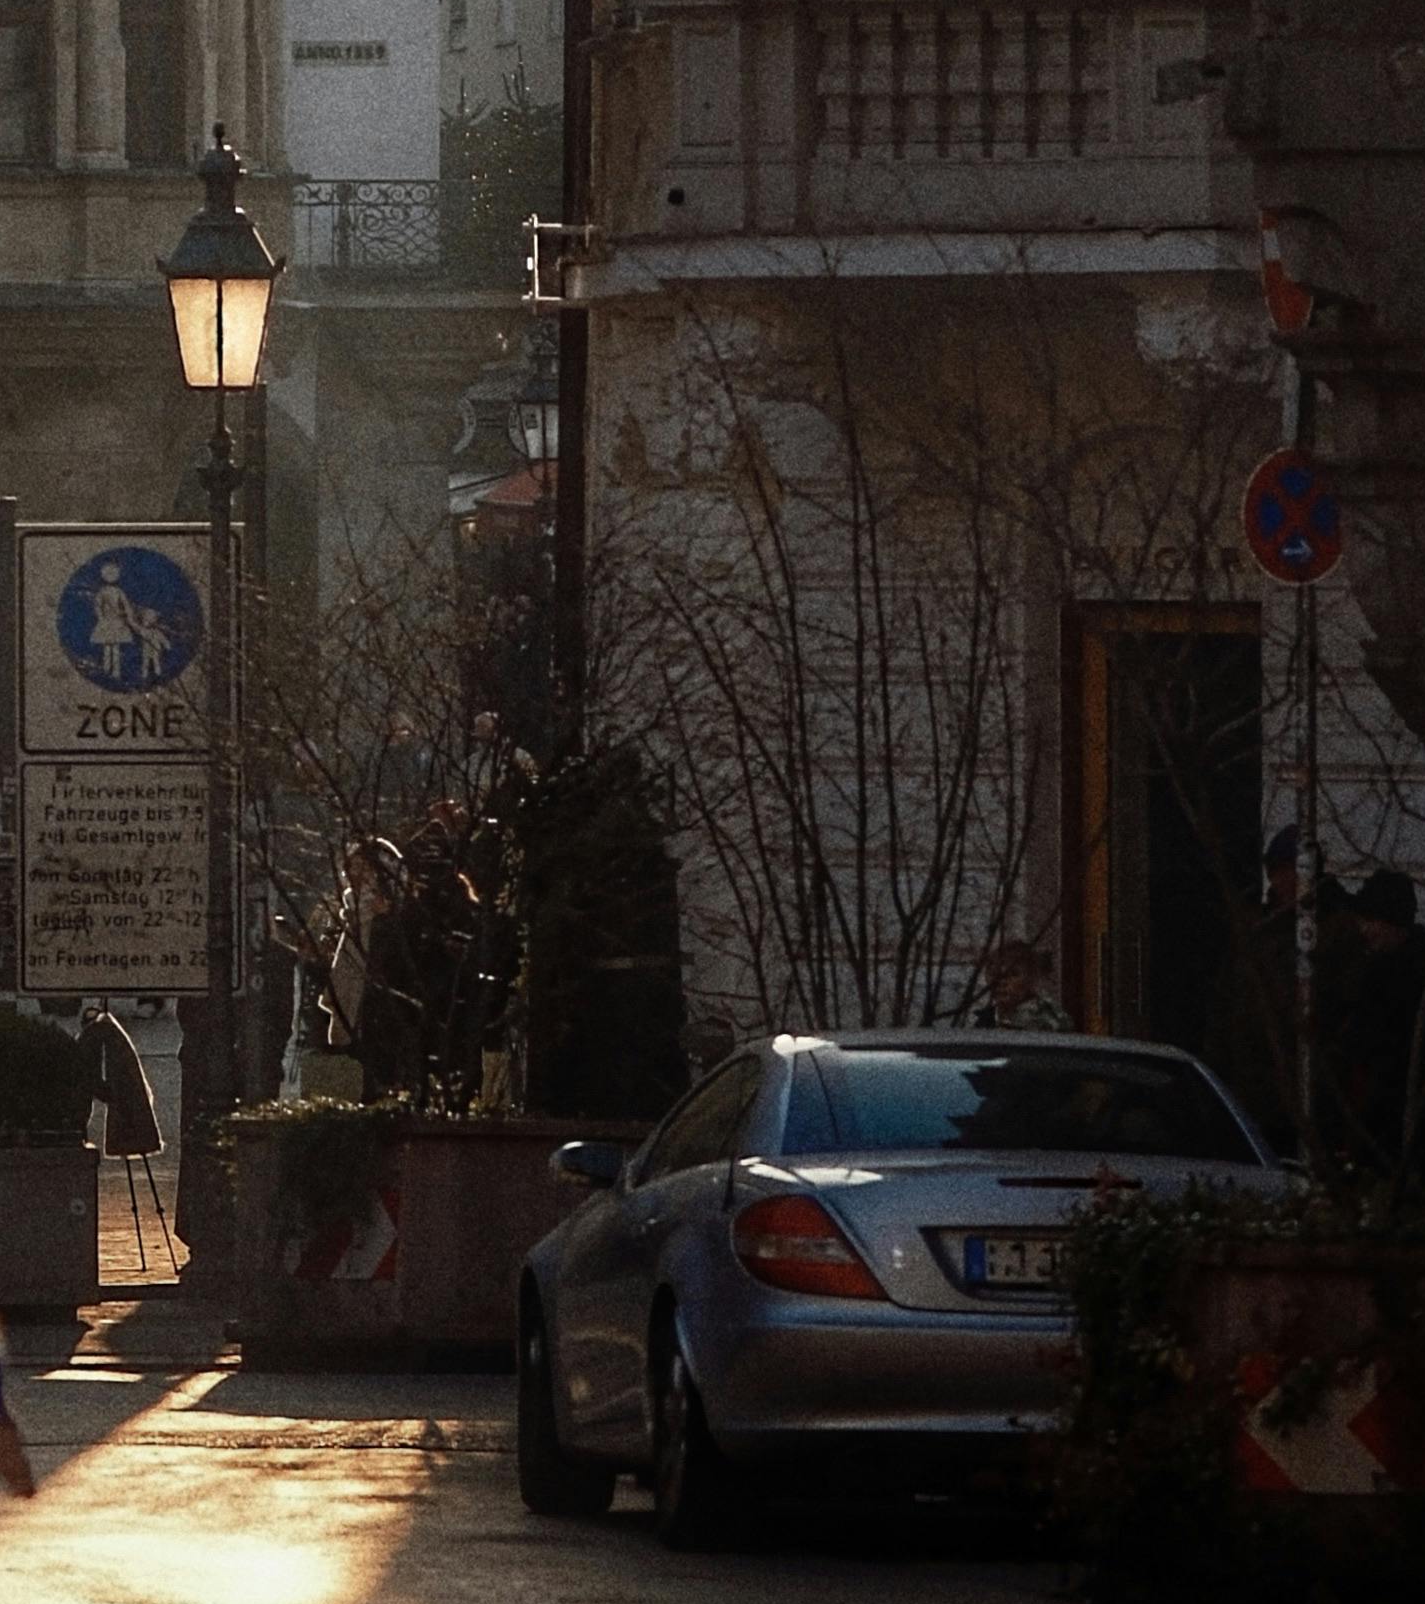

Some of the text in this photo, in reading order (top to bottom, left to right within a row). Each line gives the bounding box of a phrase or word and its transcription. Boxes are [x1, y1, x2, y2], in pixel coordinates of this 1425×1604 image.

[76, 704, 185, 739] ZONE
[45, 805, 140, 825] Fahrzeuge
[146, 806, 173, 822] bis
[70, 889, 149, 909] Samstag
[192, 890, 205, 905] h
[102, 914, 135, 928] von
[28, 954, 49, 968] an
[56, 949, 152, 970] Feiertagen
[159, 953, 181, 967] ab
